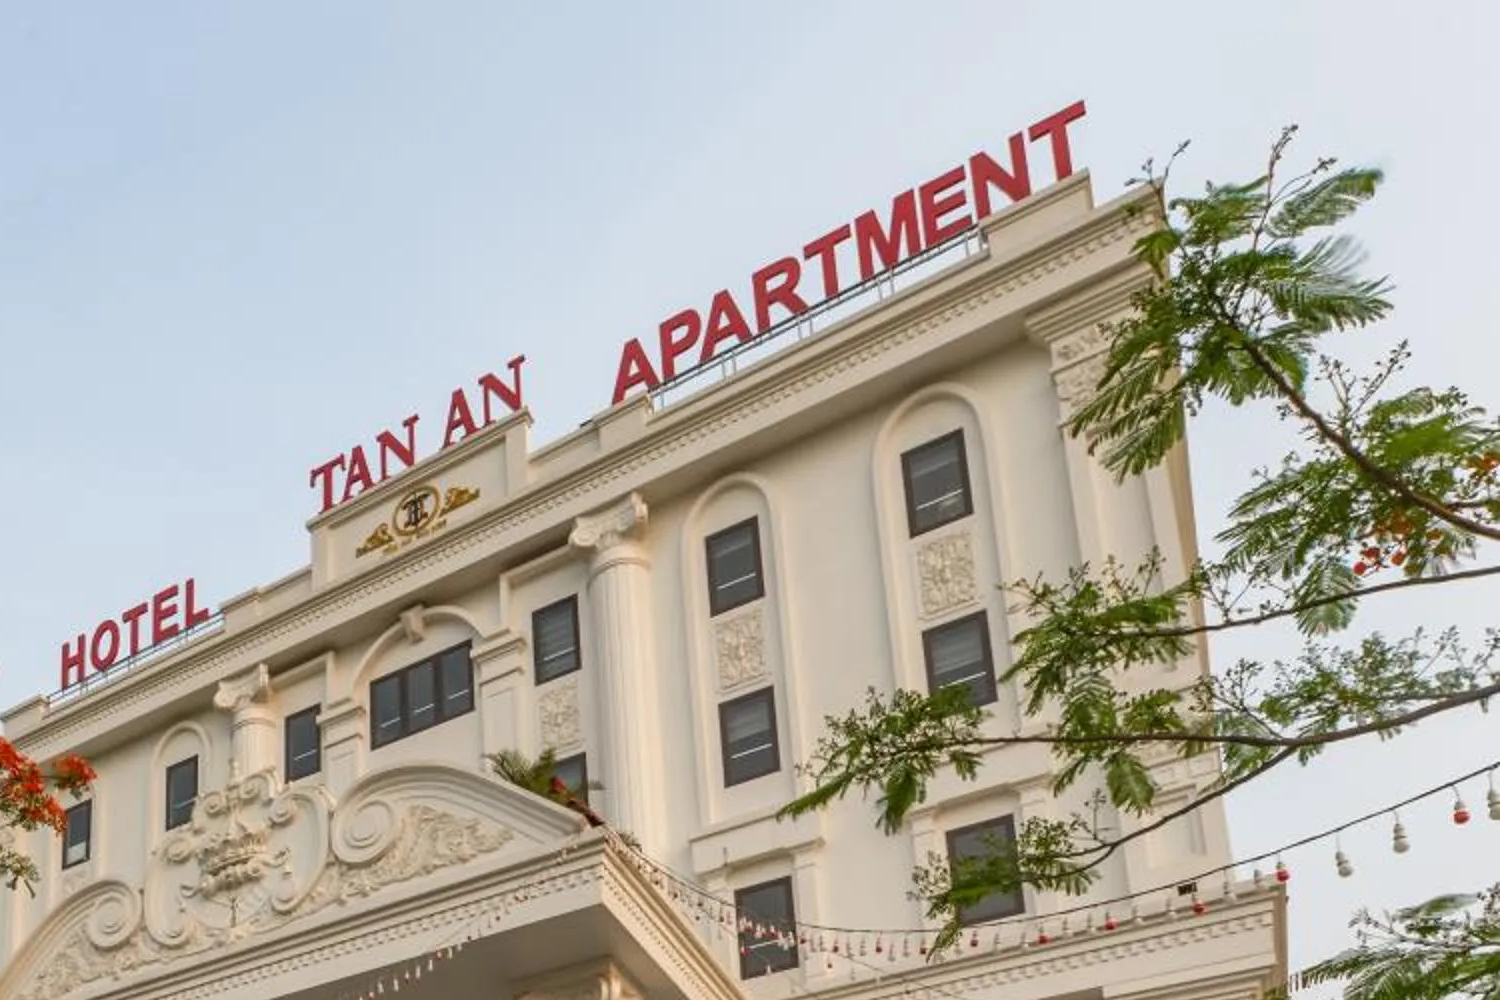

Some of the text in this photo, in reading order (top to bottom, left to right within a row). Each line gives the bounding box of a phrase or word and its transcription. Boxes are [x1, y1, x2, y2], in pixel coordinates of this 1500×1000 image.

[614, 100, 1087, 403] APARTMENT
[309, 356, 527, 514] TAN AN
[60, 578, 208, 690] HOTEL
